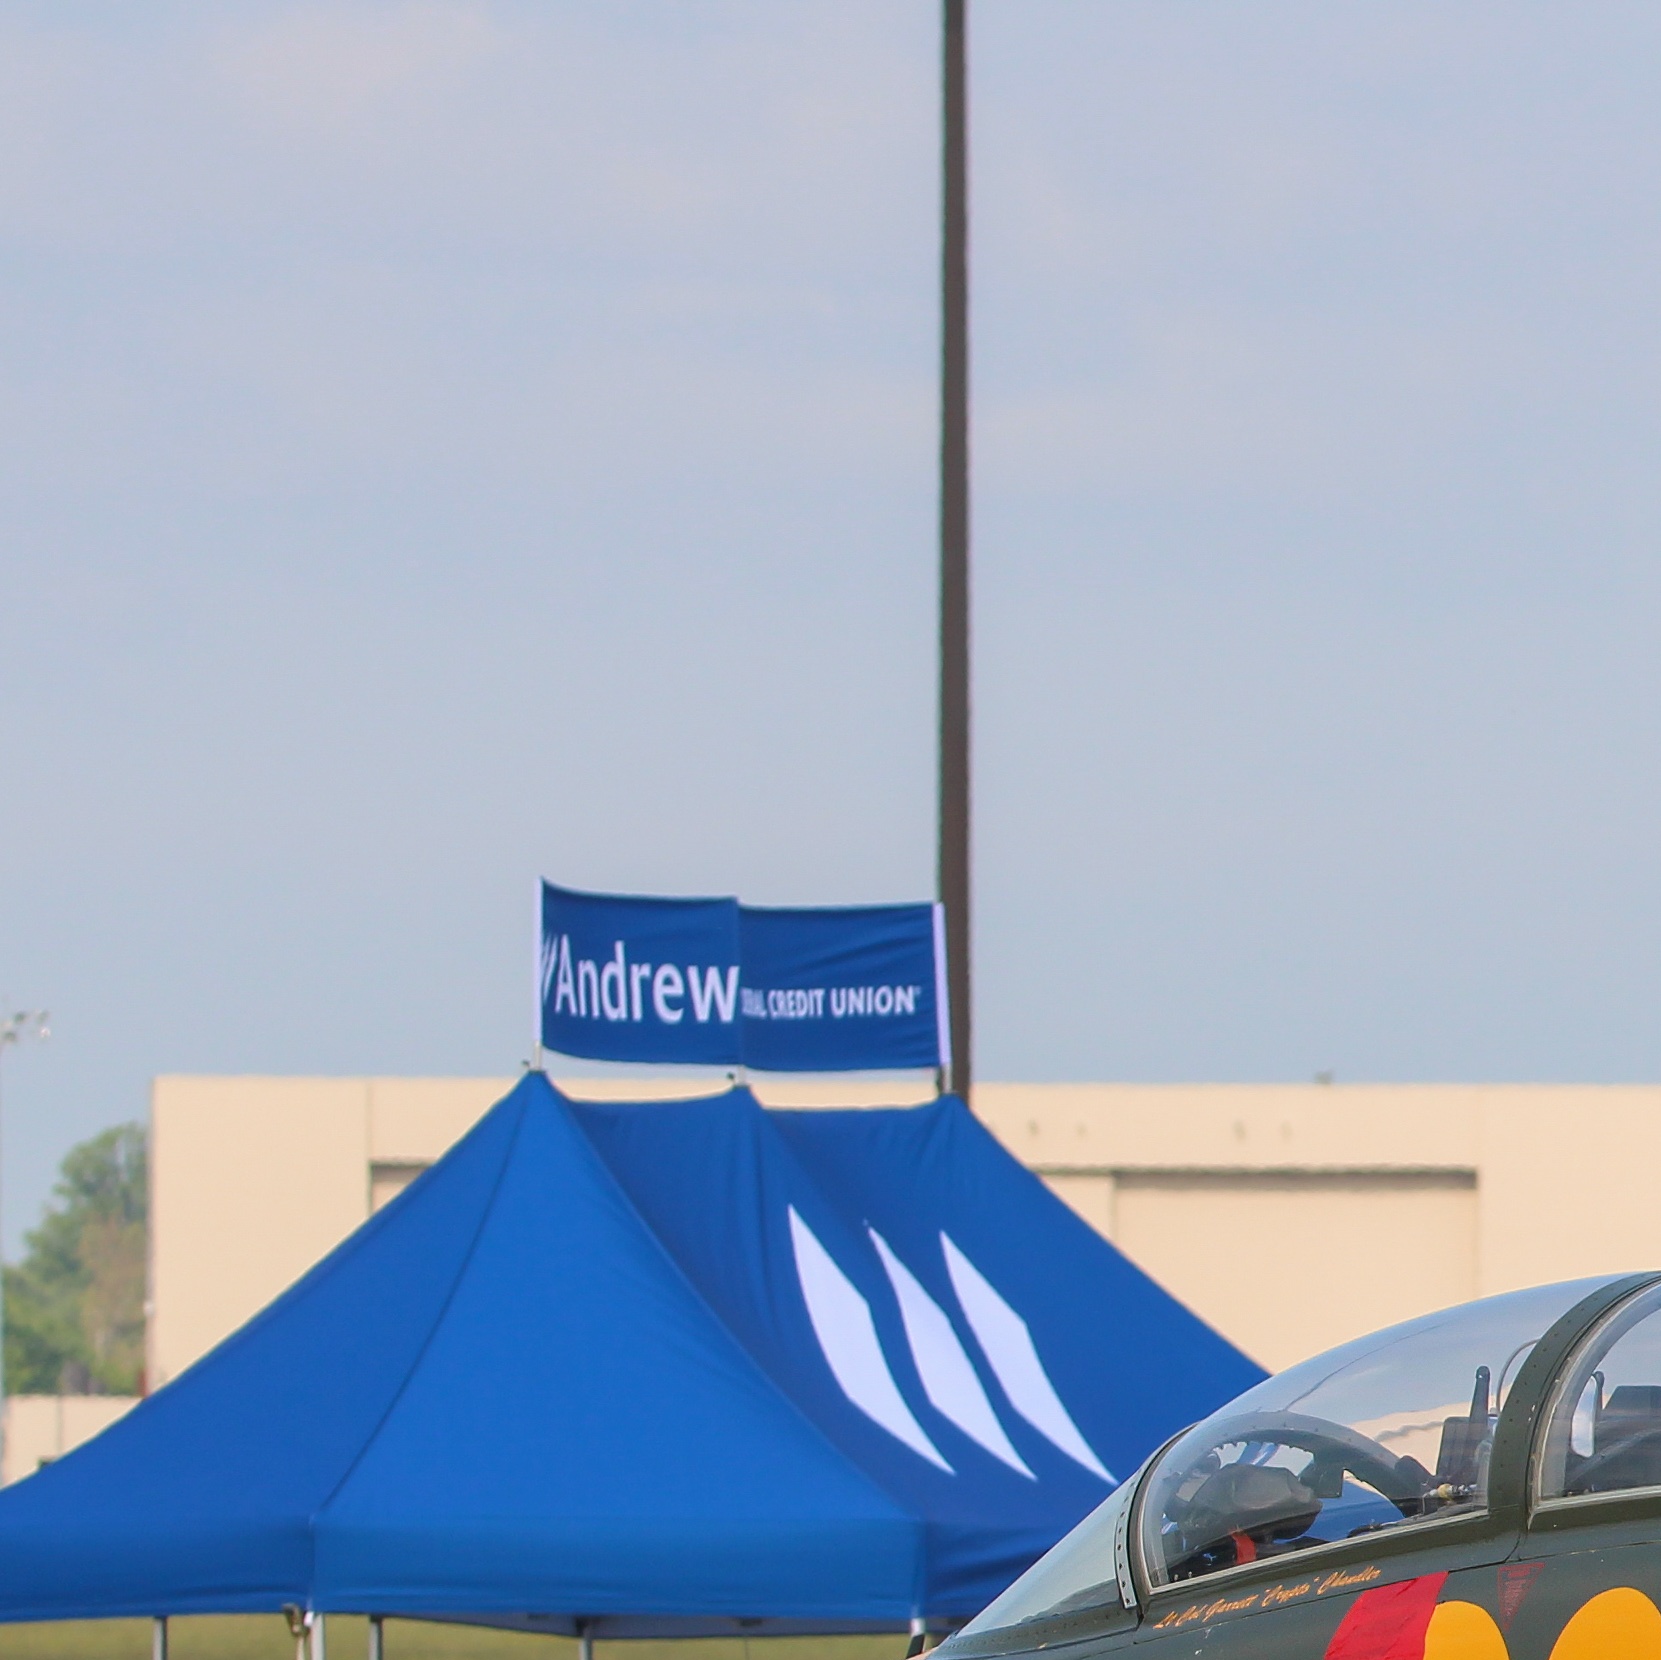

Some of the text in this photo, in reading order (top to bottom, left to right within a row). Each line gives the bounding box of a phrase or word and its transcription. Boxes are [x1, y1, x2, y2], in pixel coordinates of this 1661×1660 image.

[555, 934, 740, 1024] Andrew
[768, 988, 825, 1019] CREDIT
[830, 985, 915, 1018] UNION
